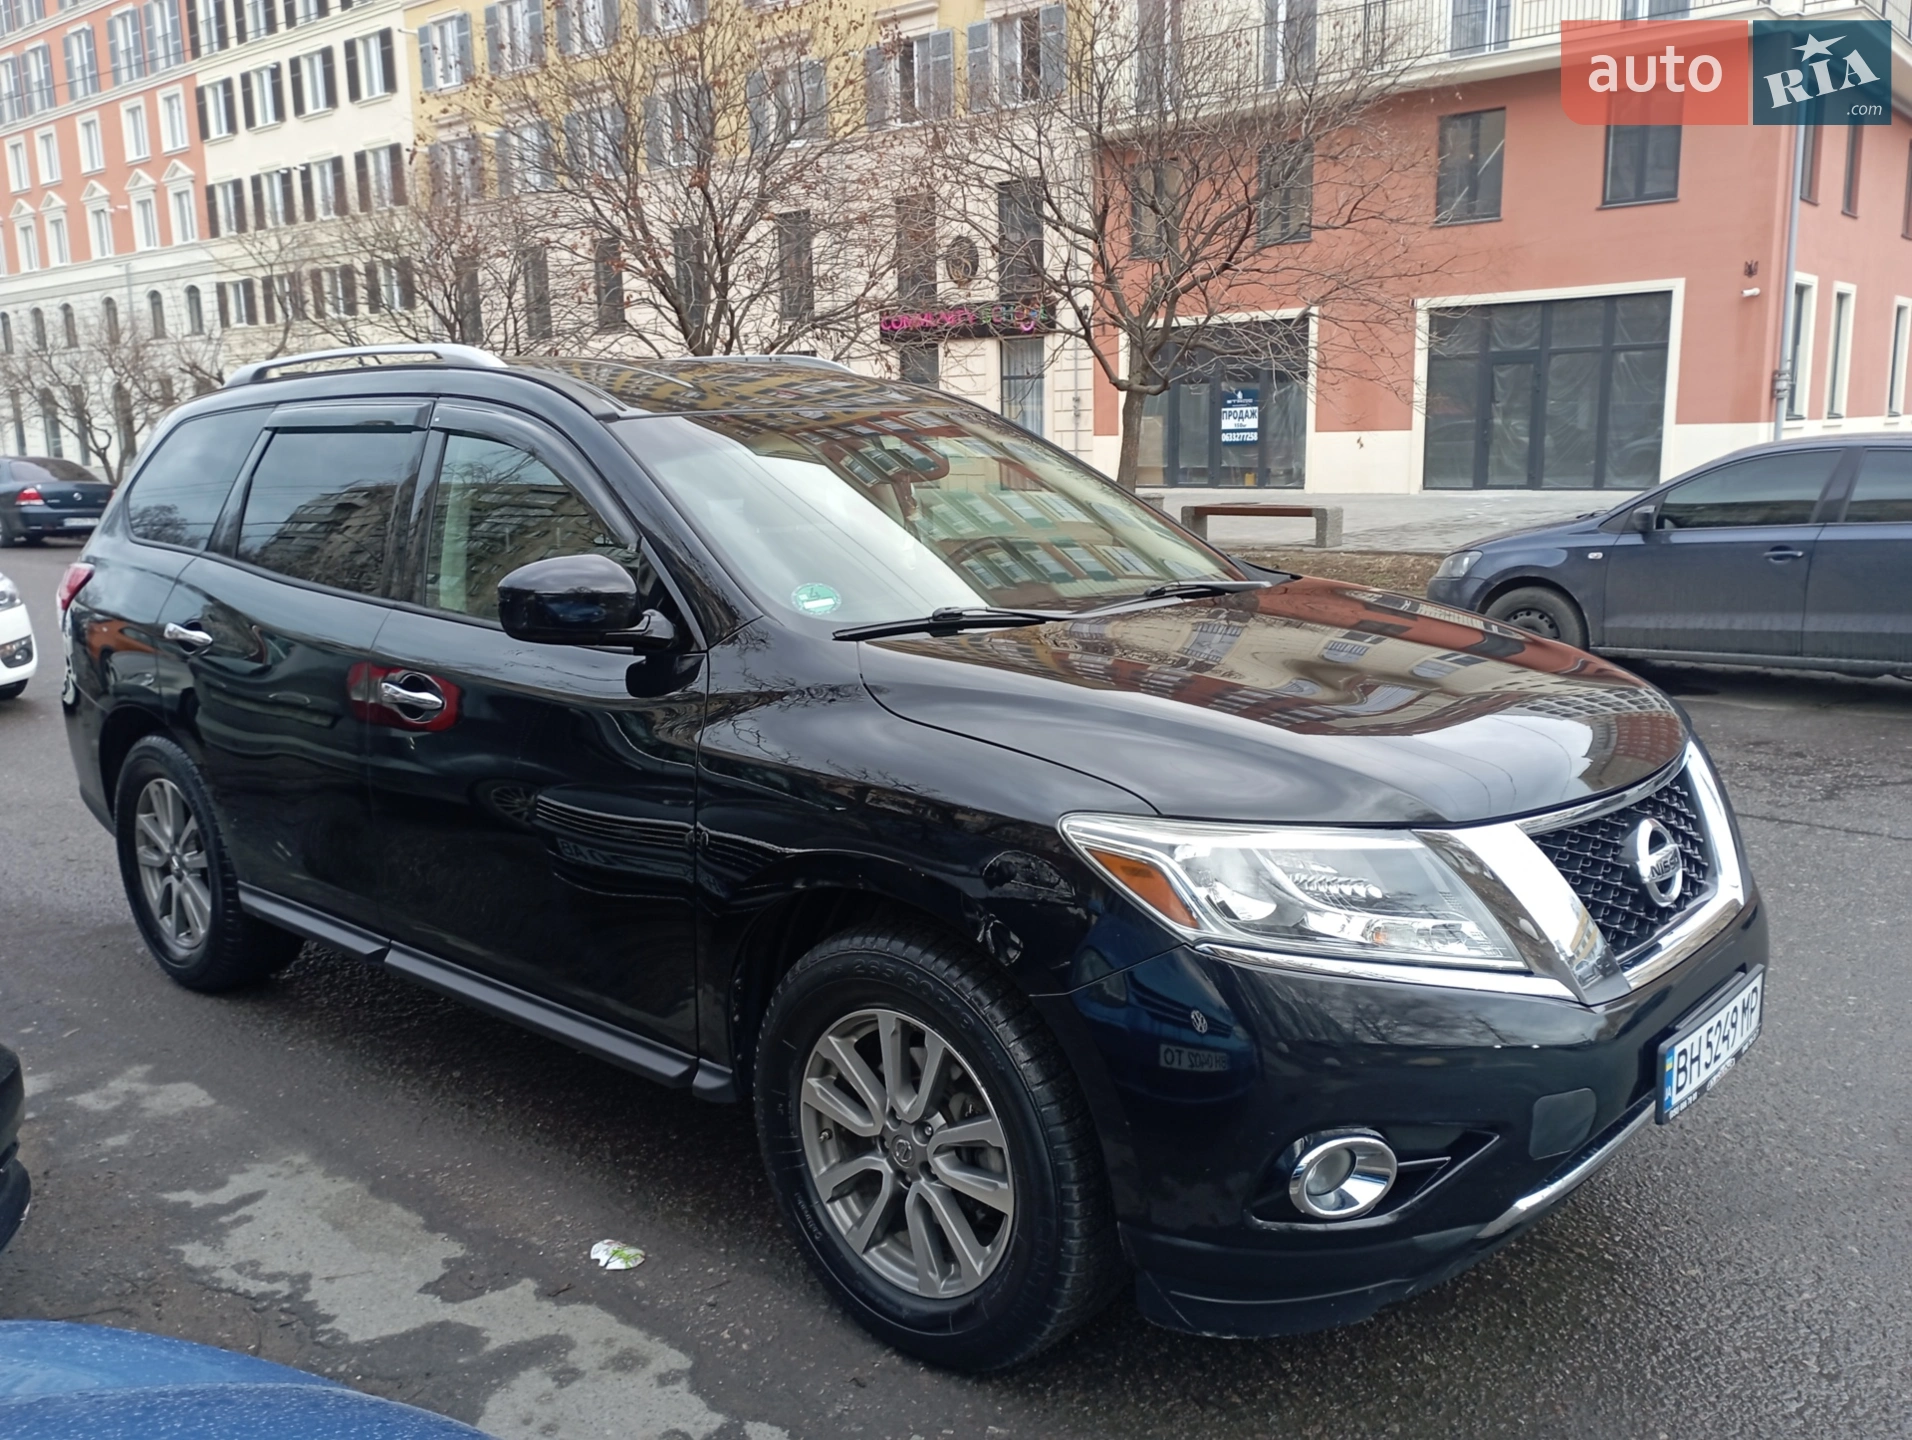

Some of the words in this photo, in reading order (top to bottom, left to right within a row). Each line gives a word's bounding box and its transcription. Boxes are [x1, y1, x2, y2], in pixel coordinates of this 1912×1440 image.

[1222, 408, 1258, 422] ПРОДАЖ
[1675, 1034, 1703, 1096] BH
[1704, 1005, 1739, 1070] 5249
[1740, 985, 1759, 1038] MP
